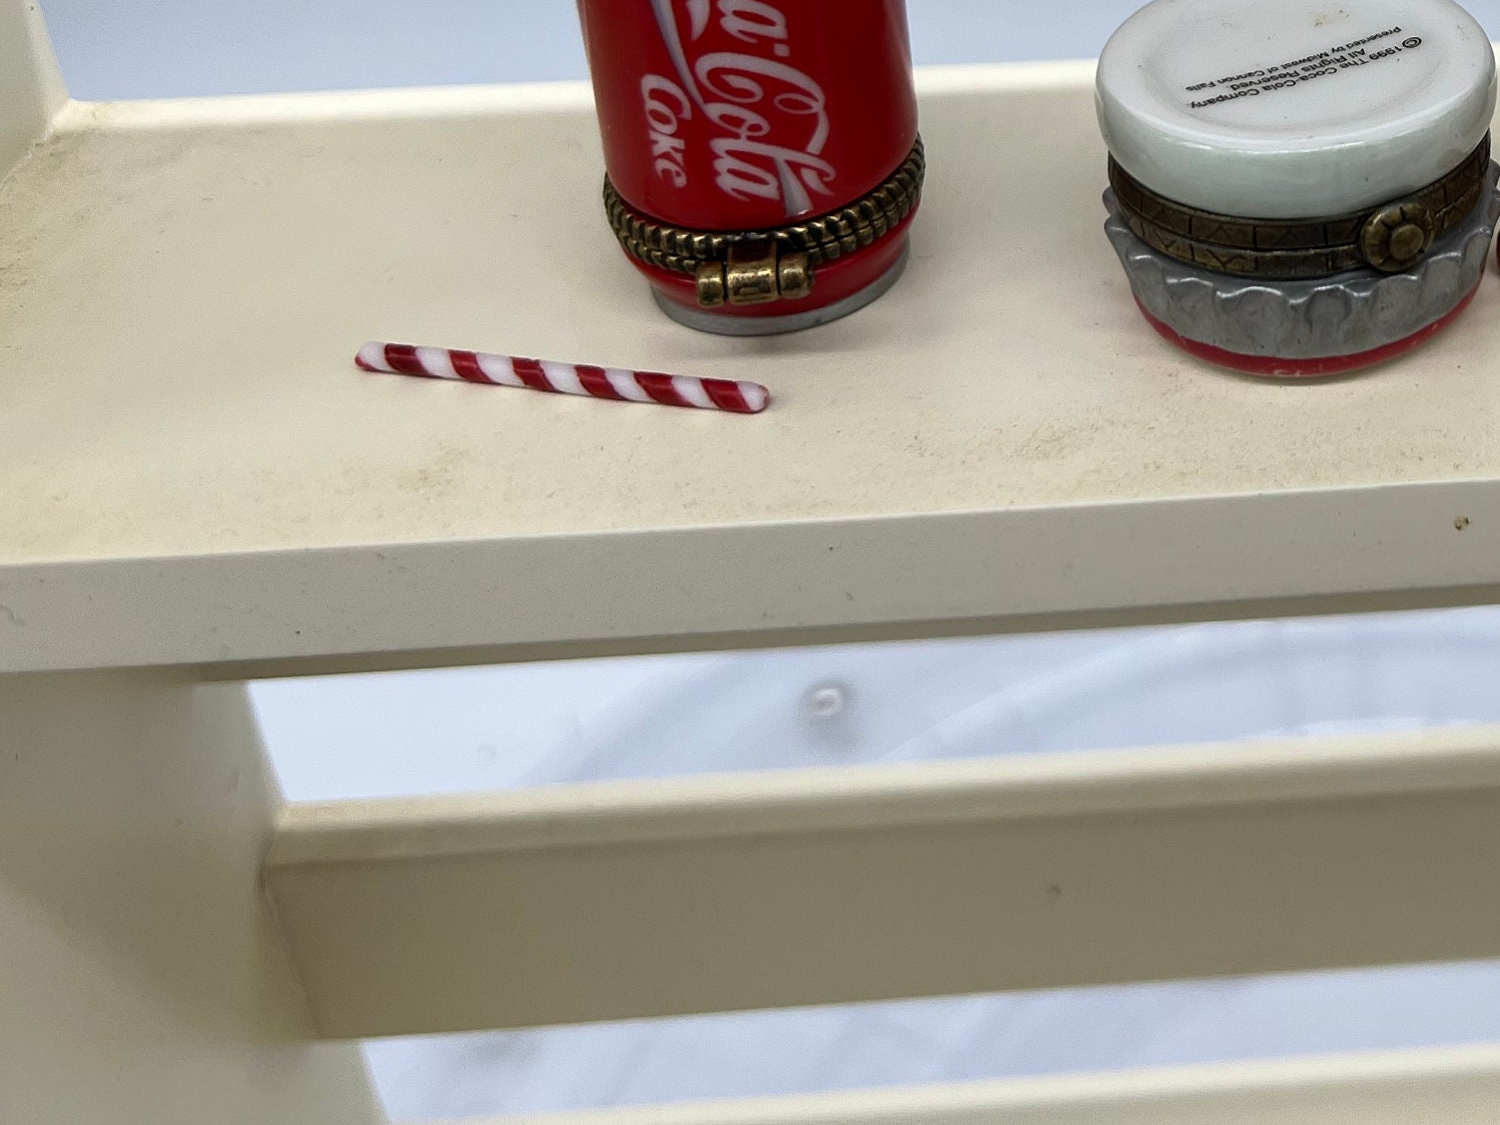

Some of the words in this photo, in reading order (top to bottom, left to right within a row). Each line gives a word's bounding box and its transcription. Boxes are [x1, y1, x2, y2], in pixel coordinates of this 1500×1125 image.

[1346, 26, 1402, 50] Presented
[1331, 43, 1347, 54] by
[1348, 48, 1366, 59] All
[1286, 51, 1330, 68] Midwest
[1301, 53, 1348, 73] Rights
[1340, 58, 1369, 70] The
[1217, 69, 1266, 84] Cannon
[1268, 64, 1286, 75] of
[1263, 66, 1338, 92] Coca-Cola
[640, 73, 693, 188] Coke
